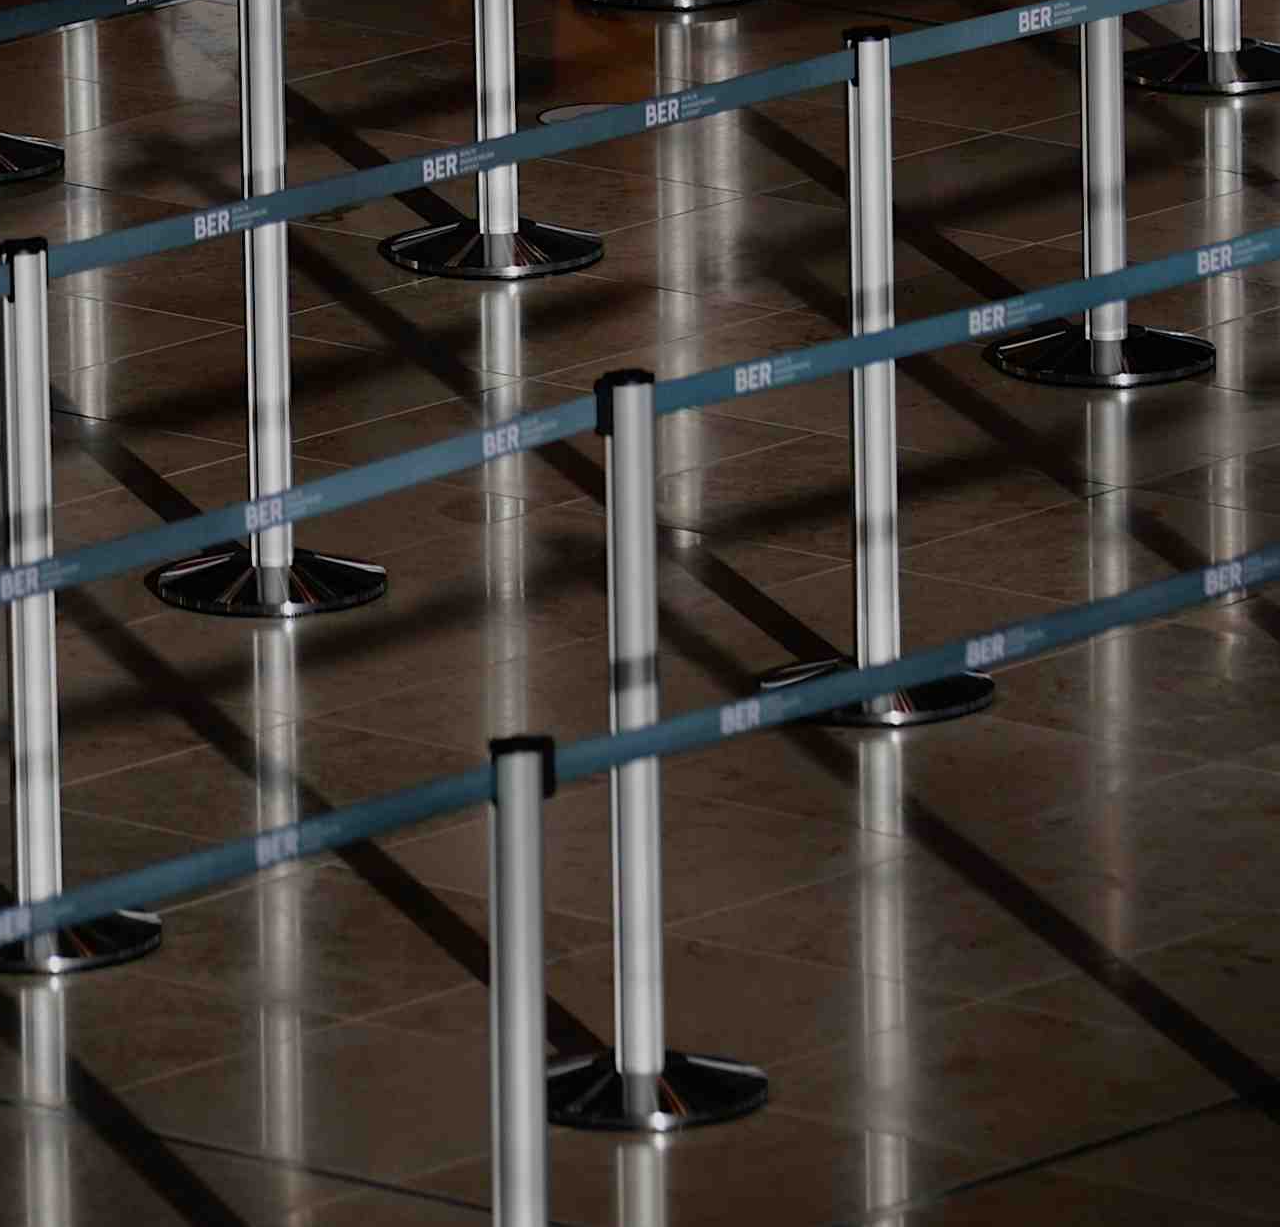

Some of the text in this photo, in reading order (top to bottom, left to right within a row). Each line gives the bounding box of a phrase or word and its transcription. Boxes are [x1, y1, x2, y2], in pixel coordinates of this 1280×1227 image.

[1019, 6, 1051, 32] BER
[645, 99, 678, 126] BER
[423, 153, 457, 180] BER
[194, 212, 230, 238] BER
[1197, 246, 1232, 274] BER
[969, 305, 1005, 333] BER
[735, 362, 771, 391] BER
[483, 427, 518, 458] BER
[245, 498, 283, 530] BER
[0, 567, 39, 600] BER
[1204, 563, 1242, 596] BER
[965, 634, 1004, 666] BER
